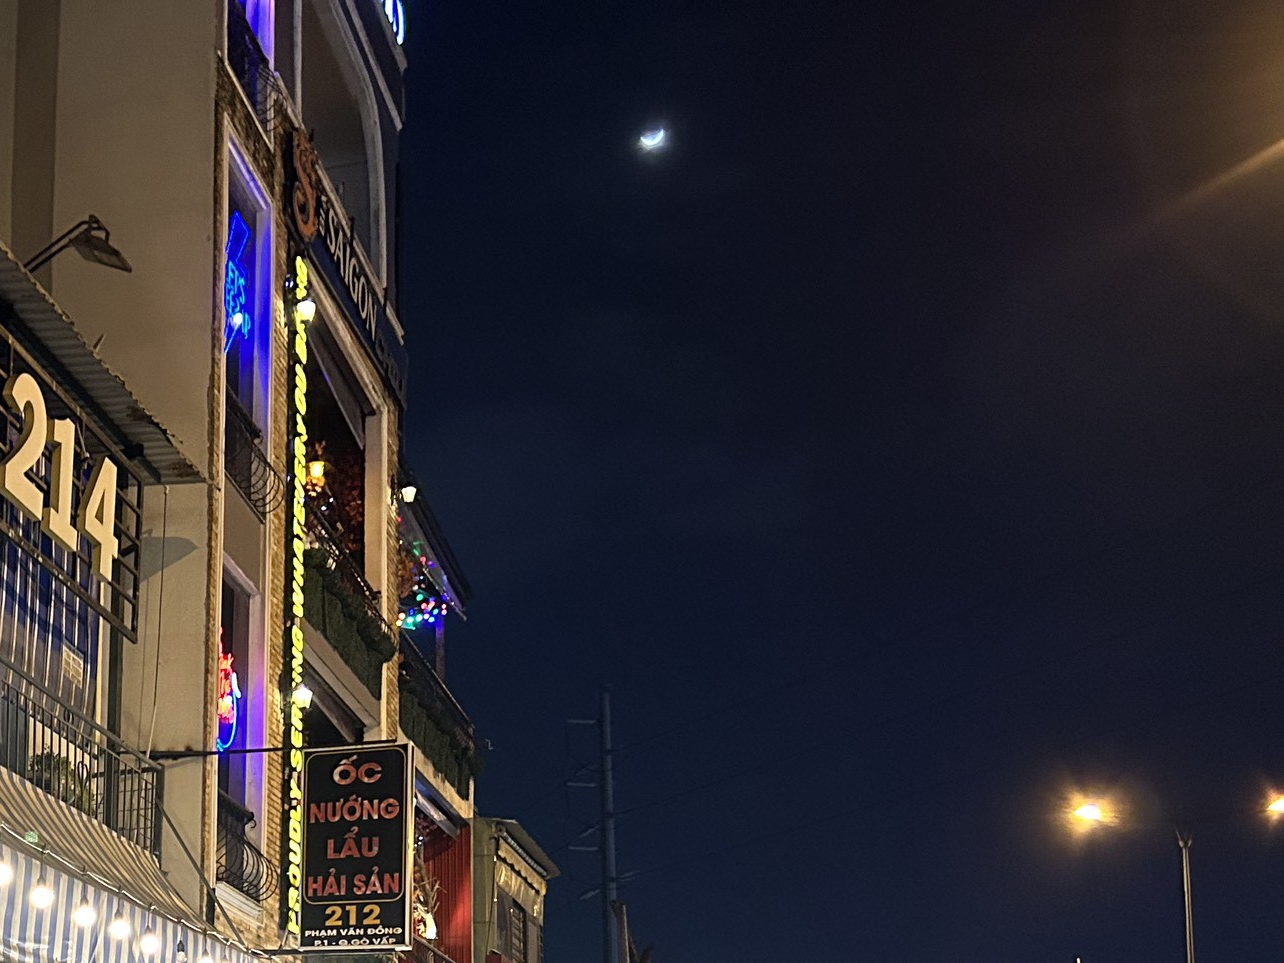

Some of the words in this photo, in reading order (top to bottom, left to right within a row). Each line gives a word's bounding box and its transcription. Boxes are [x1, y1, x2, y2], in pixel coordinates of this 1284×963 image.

[327, 207, 377, 343] SAIGON
[294, 255, 308, 365] BRNG
[294, 364, 307, 442] YOU
[0, 370, 119, 583] 214
[292, 440, 307, 618] WHATEVER
[290, 624, 305, 774] SERING
[332, 755, 382, 786] ỐC
[309, 794, 400, 824] NƯỚNG
[287, 777, 303, 936] PROUDLY
[327, 826, 380, 860] LẨU
[307, 868, 346, 897] HẢI
[353, 866, 400, 896] SẢN
[304, 928, 337, 938] PHẠM
[340, 926, 364, 937] VĂN
[324, 904, 381, 927] 212
[372, 935, 397, 946] VẤP
